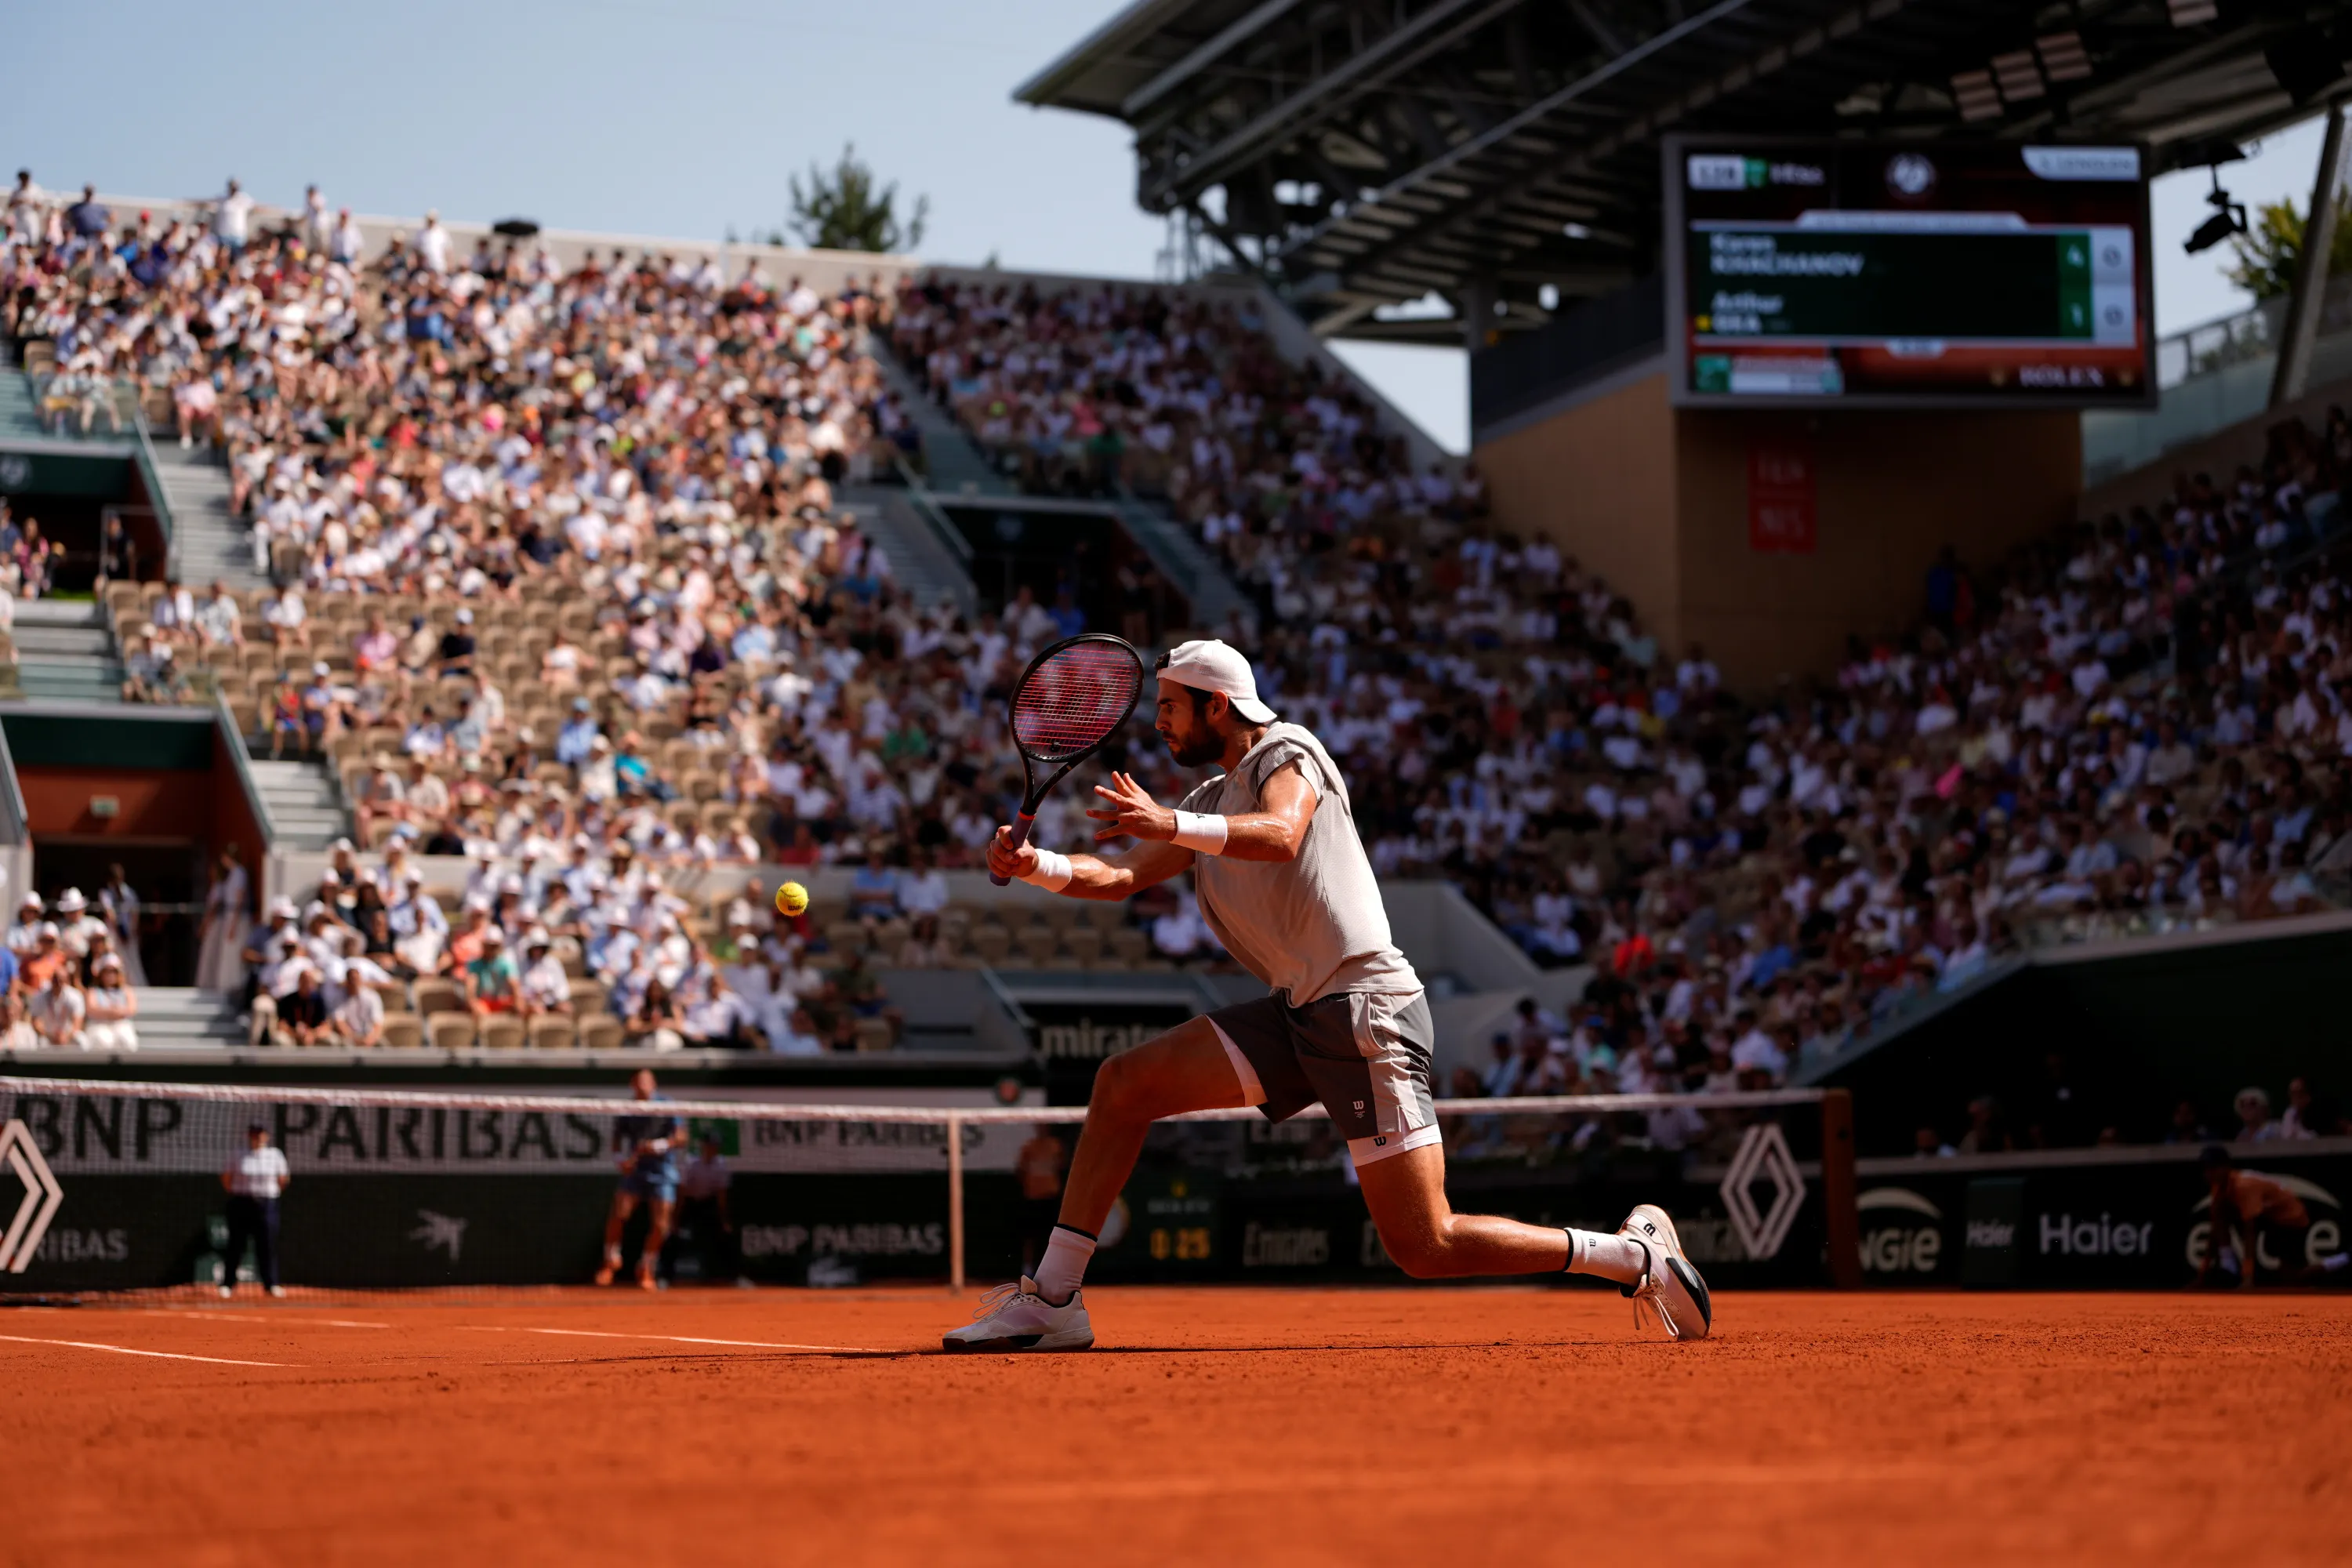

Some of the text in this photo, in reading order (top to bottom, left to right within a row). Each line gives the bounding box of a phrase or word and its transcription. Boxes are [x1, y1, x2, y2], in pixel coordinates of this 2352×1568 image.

[16, 1096, 601, 1160] BNP PARIBAS
[741, 1221, 945, 1257] BNP PARIBAS
[1965, 1216, 2015, 1248] Haier
[2039, 1209, 2154, 1256] Haier
